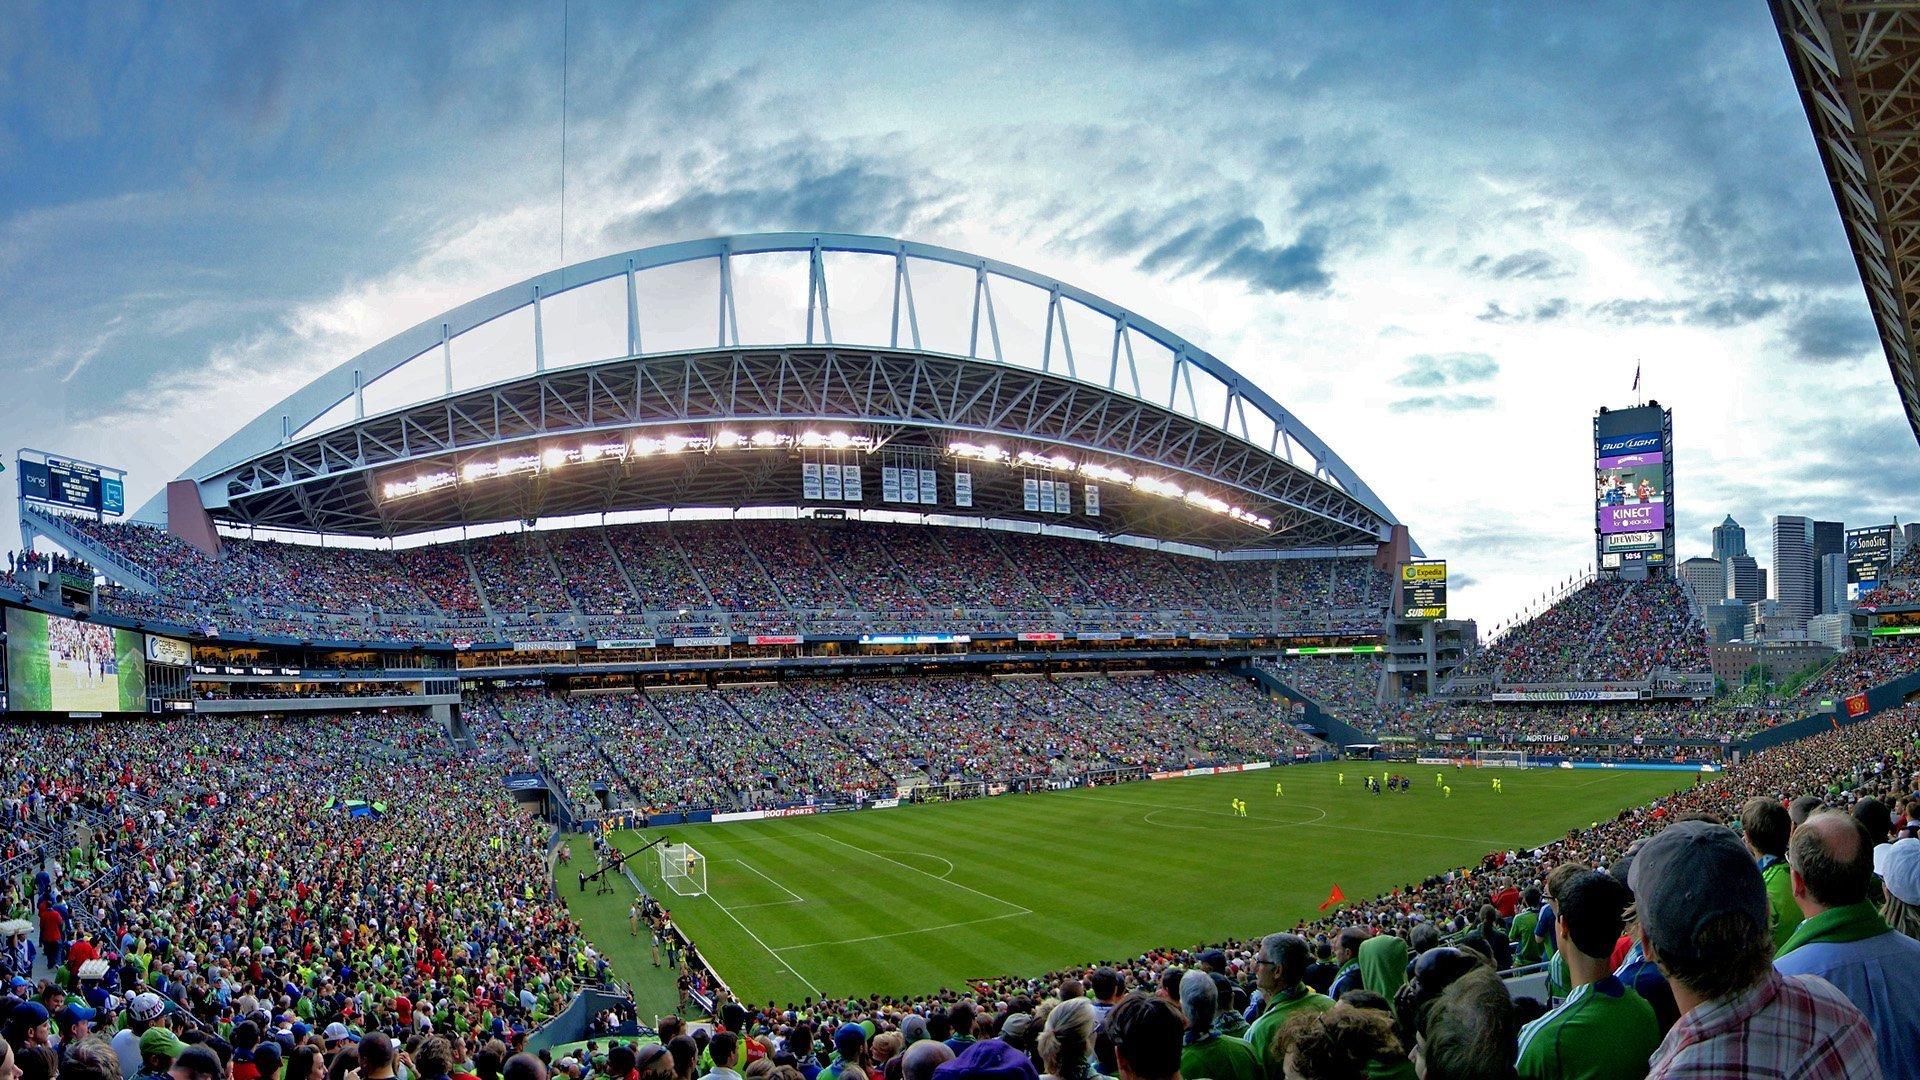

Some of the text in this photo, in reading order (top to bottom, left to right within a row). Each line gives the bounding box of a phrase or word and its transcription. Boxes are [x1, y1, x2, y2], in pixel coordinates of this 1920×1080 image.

[1602, 438, 1658, 451] BUD LIGHT
[26, 474, 46, 488] bing
[1613, 507, 1653, 520] KINECT
[1858, 536, 1886, 548] SonoSite
[1416, 568, 1442, 577] Expedia
[1405, 608, 1445, 618] SUBWAY
[610, 640, 651, 649] walottery.com
[685, 637, 710, 645] Qwest
[764, 809, 786, 818] ROOT
